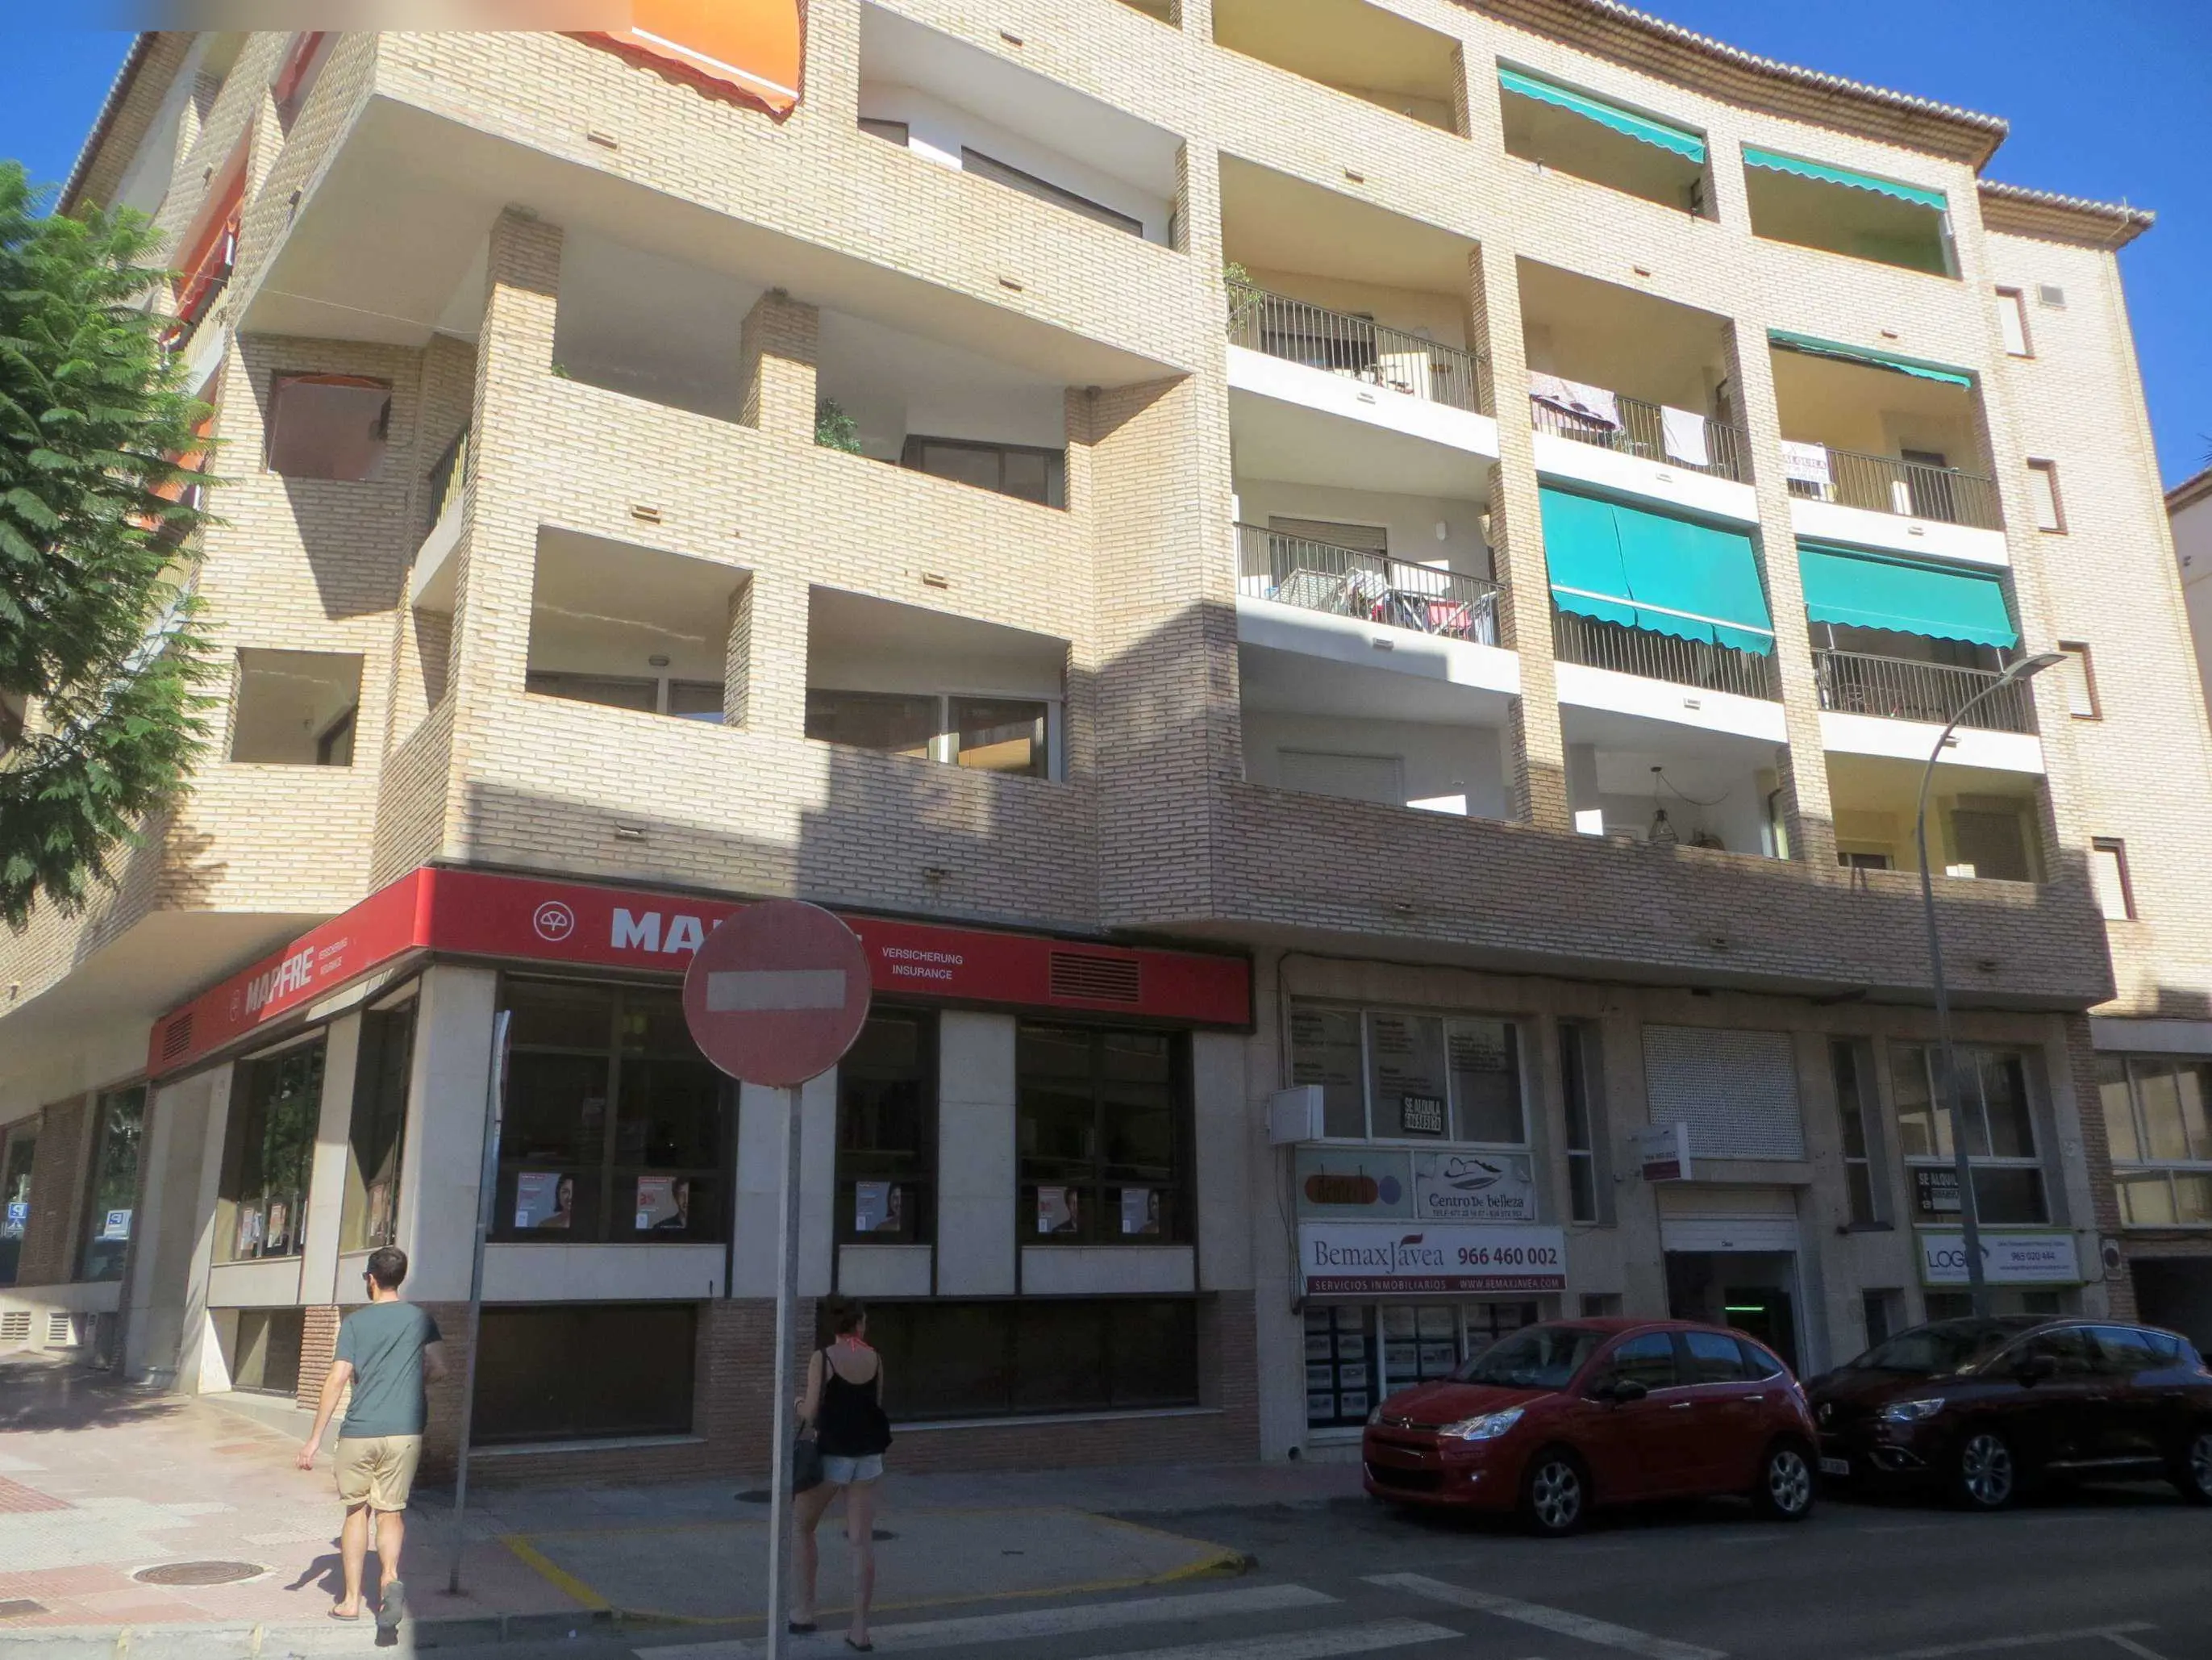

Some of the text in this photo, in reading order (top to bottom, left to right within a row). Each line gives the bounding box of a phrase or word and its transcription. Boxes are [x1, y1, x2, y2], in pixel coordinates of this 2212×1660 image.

[881, 946, 964, 965] VERSICHERUNG
[892, 964, 952, 979] INSURANCE
[245, 945, 315, 1015] MAPFRE
[1918, 1173, 1959, 1186] SE ALQUIL
[1428, 1192, 1470, 1207] Centro
[1486, 1194, 1524, 1207] belleza
[1457, 1247, 1489, 1266] 966
[1493, 1247, 1523, 1266] 460
[1527, 1247, 1557, 1266] 002
[1315, 1278, 1559, 1291] SERVICIOS INMOBILIARIOS WWW.BEMAXJAVEA.COM
